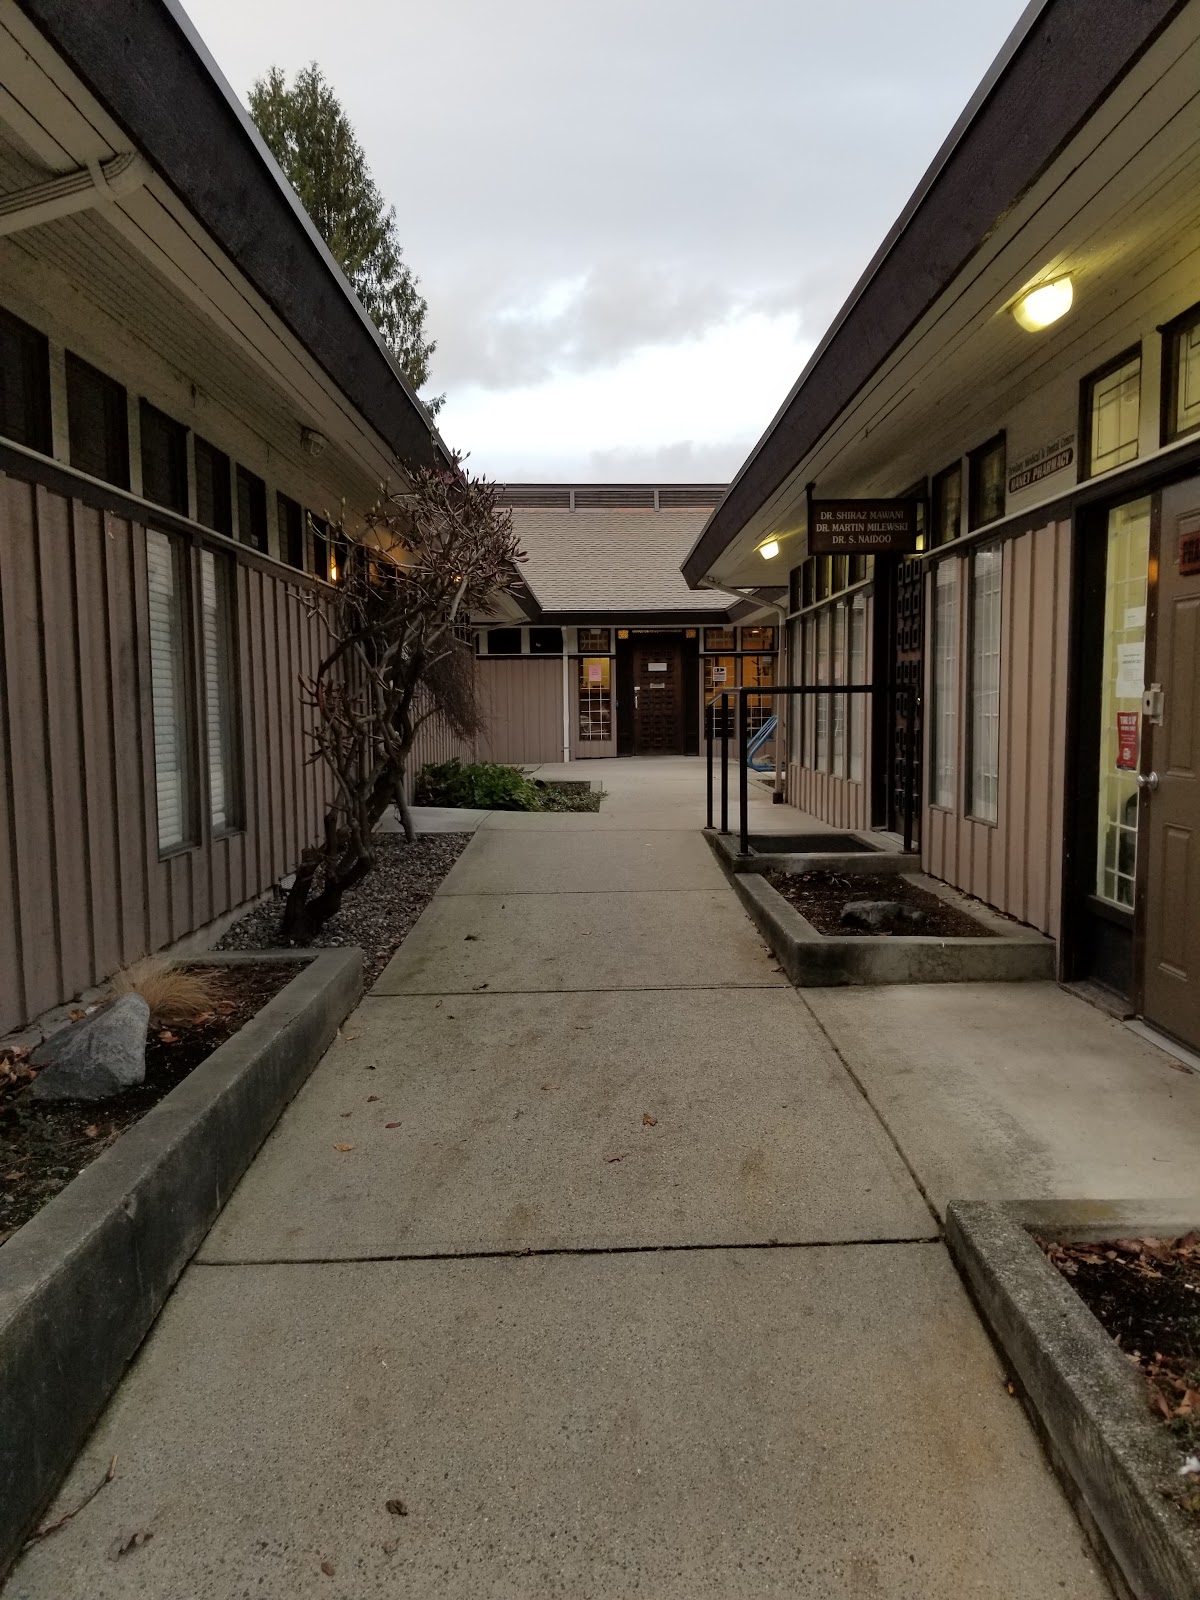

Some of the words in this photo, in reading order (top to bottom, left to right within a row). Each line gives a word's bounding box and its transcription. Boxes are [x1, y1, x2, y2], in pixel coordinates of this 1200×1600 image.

[1033, 449, 1071, 481] PHARMACY
[820, 511, 834, 520] DR.
[836, 511, 867, 520] SHIRAZ
[869, 510, 904, 520] MAWANI
[816, 523, 830, 532] DR.
[832, 523, 865, 532] MARTIN
[867, 522, 908, 532] MILEWSKI
[832, 535, 846, 544] DR.
[848, 535, 856, 544] S.
[858, 534, 892, 544] NAIDOO
